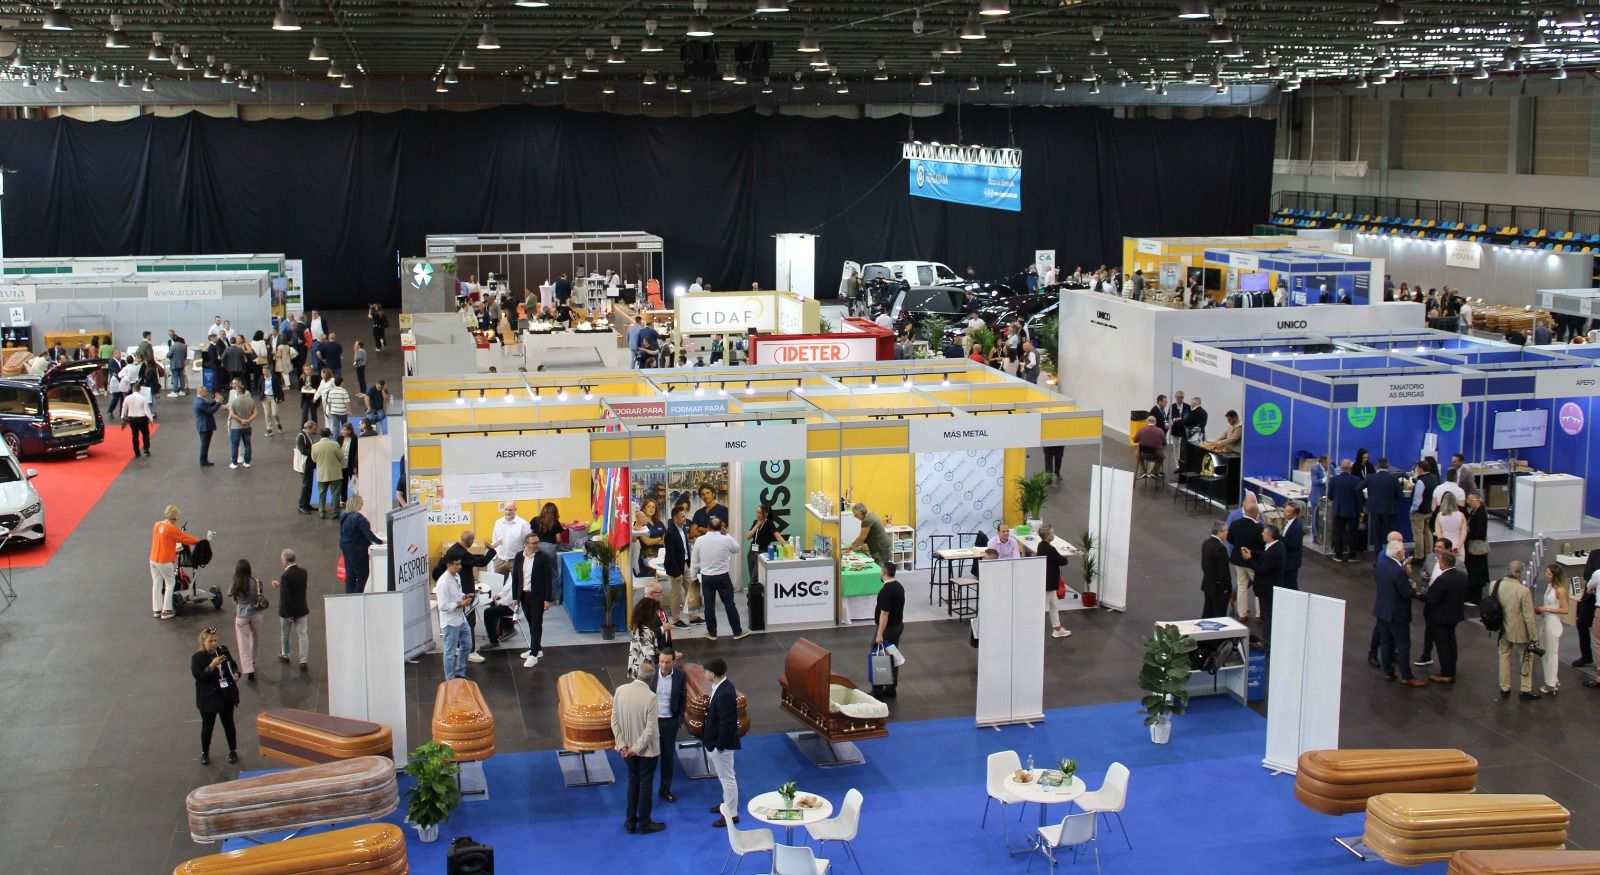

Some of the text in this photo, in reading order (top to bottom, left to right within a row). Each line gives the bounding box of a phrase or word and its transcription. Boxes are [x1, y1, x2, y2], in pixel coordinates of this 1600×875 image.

[691, 311, 752, 325] CIDAF
[1277, 321, 1308, 329] UNICO
[783, 345, 841, 361] IDETER
[944, 429, 988, 439] MÁS METAL
[725, 441, 747, 449] IMSC
[496, 449, 537, 458] AESPROF
[774, 581, 823, 599] IMSC
